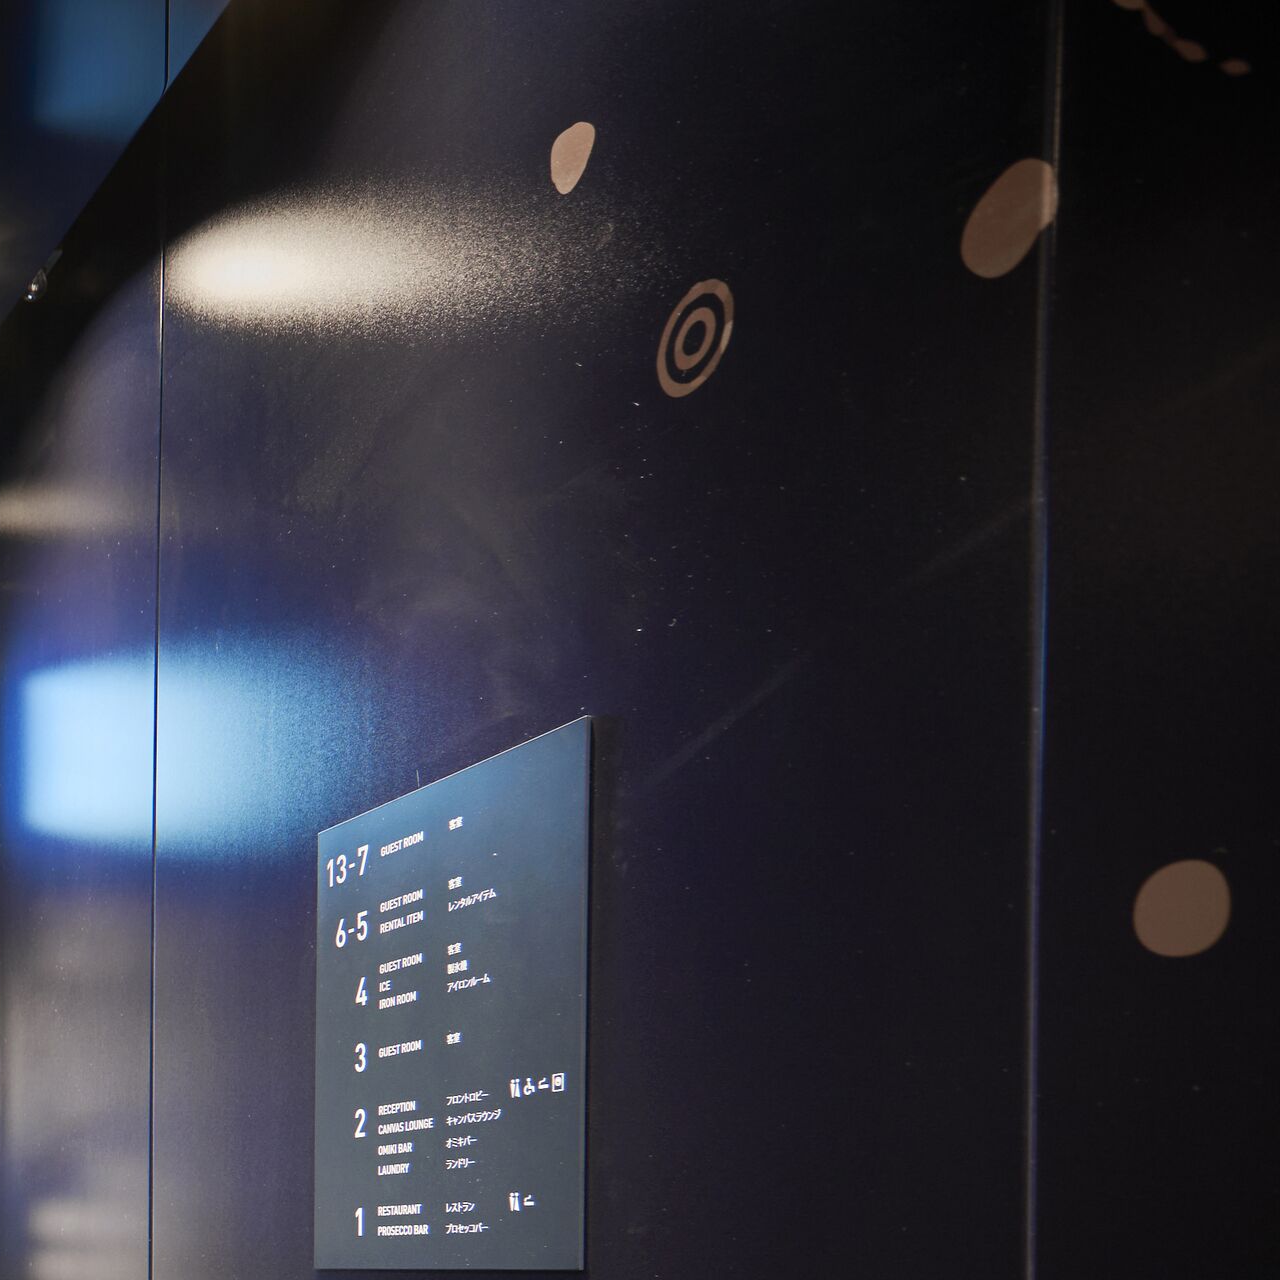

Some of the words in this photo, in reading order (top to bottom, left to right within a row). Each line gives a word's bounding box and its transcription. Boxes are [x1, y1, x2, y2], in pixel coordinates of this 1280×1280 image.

[448, 816, 463, 831] 客室
[380, 840, 402, 857] GUEST
[403, 832, 424, 848] ROOM
[327, 844, 369, 888] 13-7
[448, 877, 462, 890] 客室
[380, 897, 402, 913] GUEST
[403, 889, 423, 906] ROOM
[447, 888, 496, 912] レンタルアイテム
[335, 911, 368, 949] 6-5
[380, 915, 406, 934] RENTAL
[407, 910, 424, 927] ITEM
[447, 942, 462, 956] 客室
[380, 960, 401, 974] GUEST
[402, 953, 423, 968] ROOM
[355, 976, 368, 1006] 4
[379, 980, 391, 993] ICE
[447, 973, 491, 993] アイロンルーム
[379, 997, 396, 1010] IRON
[397, 991, 417, 1007] ROOM
[446, 1032, 461, 1045] 客室
[378, 1044, 400, 1058] GUEST
[401, 1040, 422, 1054] ROOM
[354, 1043, 367, 1073] 3
[446, 1090, 490, 1106] フロントロビー
[378, 1101, 416, 1116] RECEPTION
[354, 1108, 367, 1139] 2
[378, 1121, 404, 1135] CANVAS
[405, 1118, 434, 1132] LOUNGE
[378, 1143, 397, 1156] OMIKI
[398, 1142, 413, 1154] BAR
[446, 1135, 478, 1149] オミキバー
[378, 1163, 410, 1176] LAUNDRY
[445, 1158, 476, 1170] ランドリー
[378, 1204, 422, 1216] RESTAURANT
[445, 1201, 476, 1213] レストラン
[354, 1207, 364, 1236] 1
[445, 1223, 489, 1236] プロセッコバー
[378, 1225, 412, 1236] PROSECCO
[414, 1224, 430, 1235] BAR
